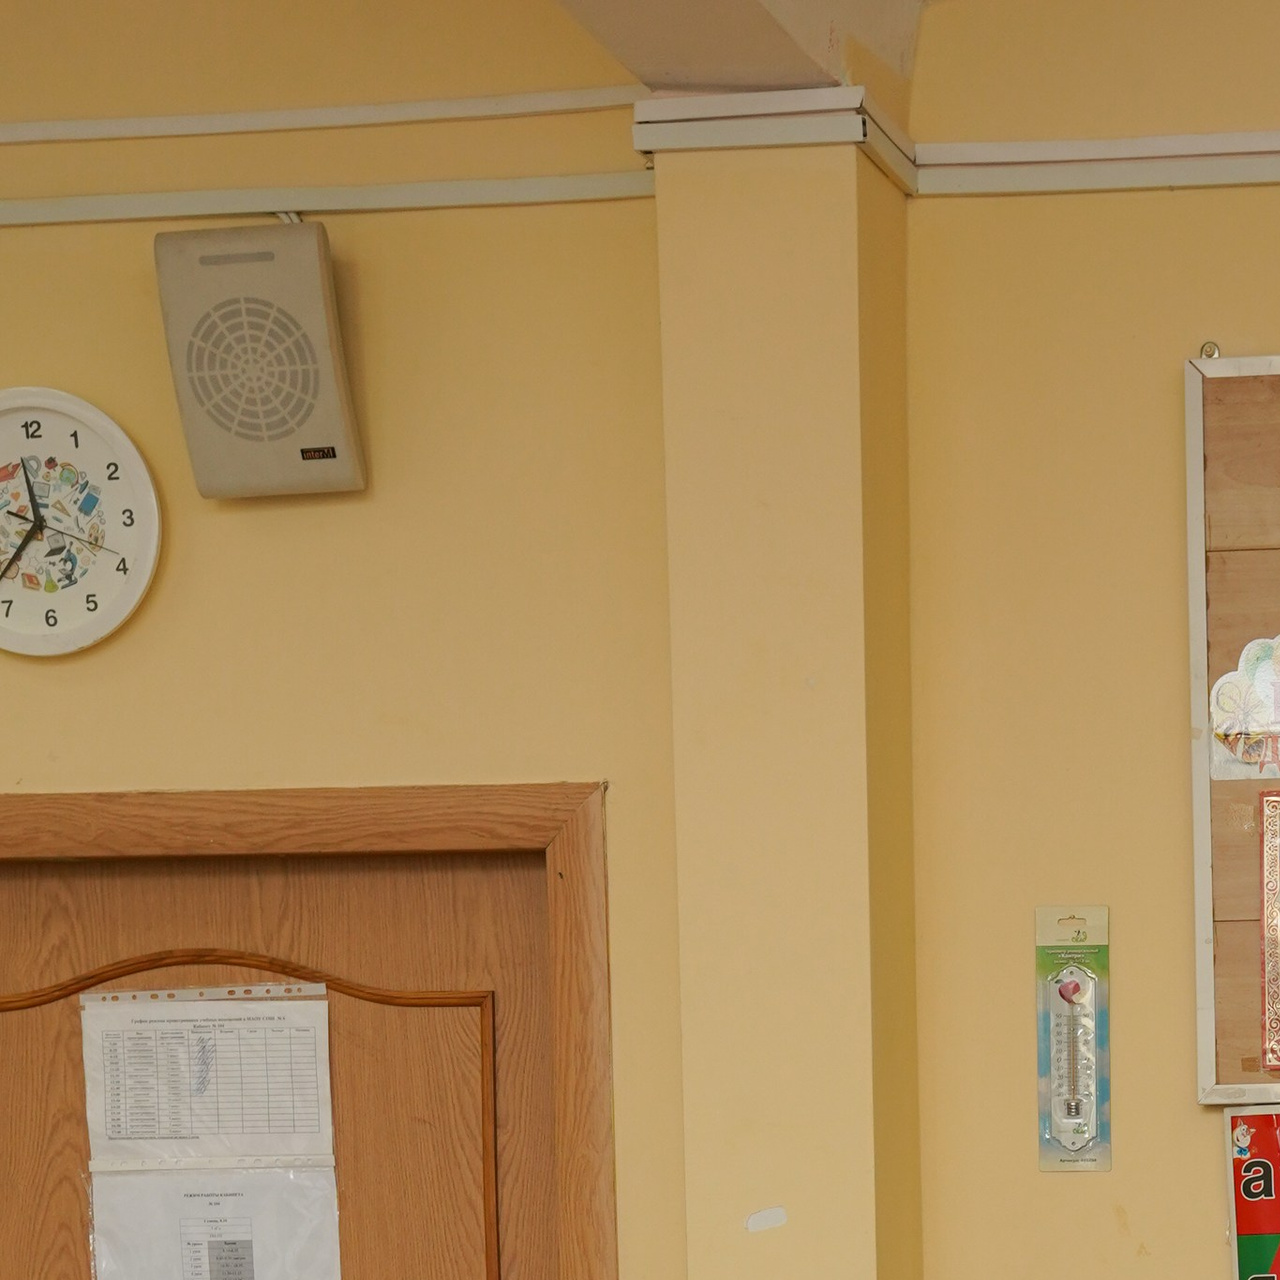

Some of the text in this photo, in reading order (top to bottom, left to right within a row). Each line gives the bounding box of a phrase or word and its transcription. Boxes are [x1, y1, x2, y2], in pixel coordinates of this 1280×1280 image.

[21, 420, 42, 439] 12
[70, 430, 79, 448] 1
[106, 462, 120, 481] 2
[122, 509, 135, 527] 3
[116, 557, 129, 575] 4
[1, 600, 13, 617] 7
[86, 594, 98, 612] 5
[45, 609, 57, 627] 6
[1241, 1158, 1275, 1199] а
